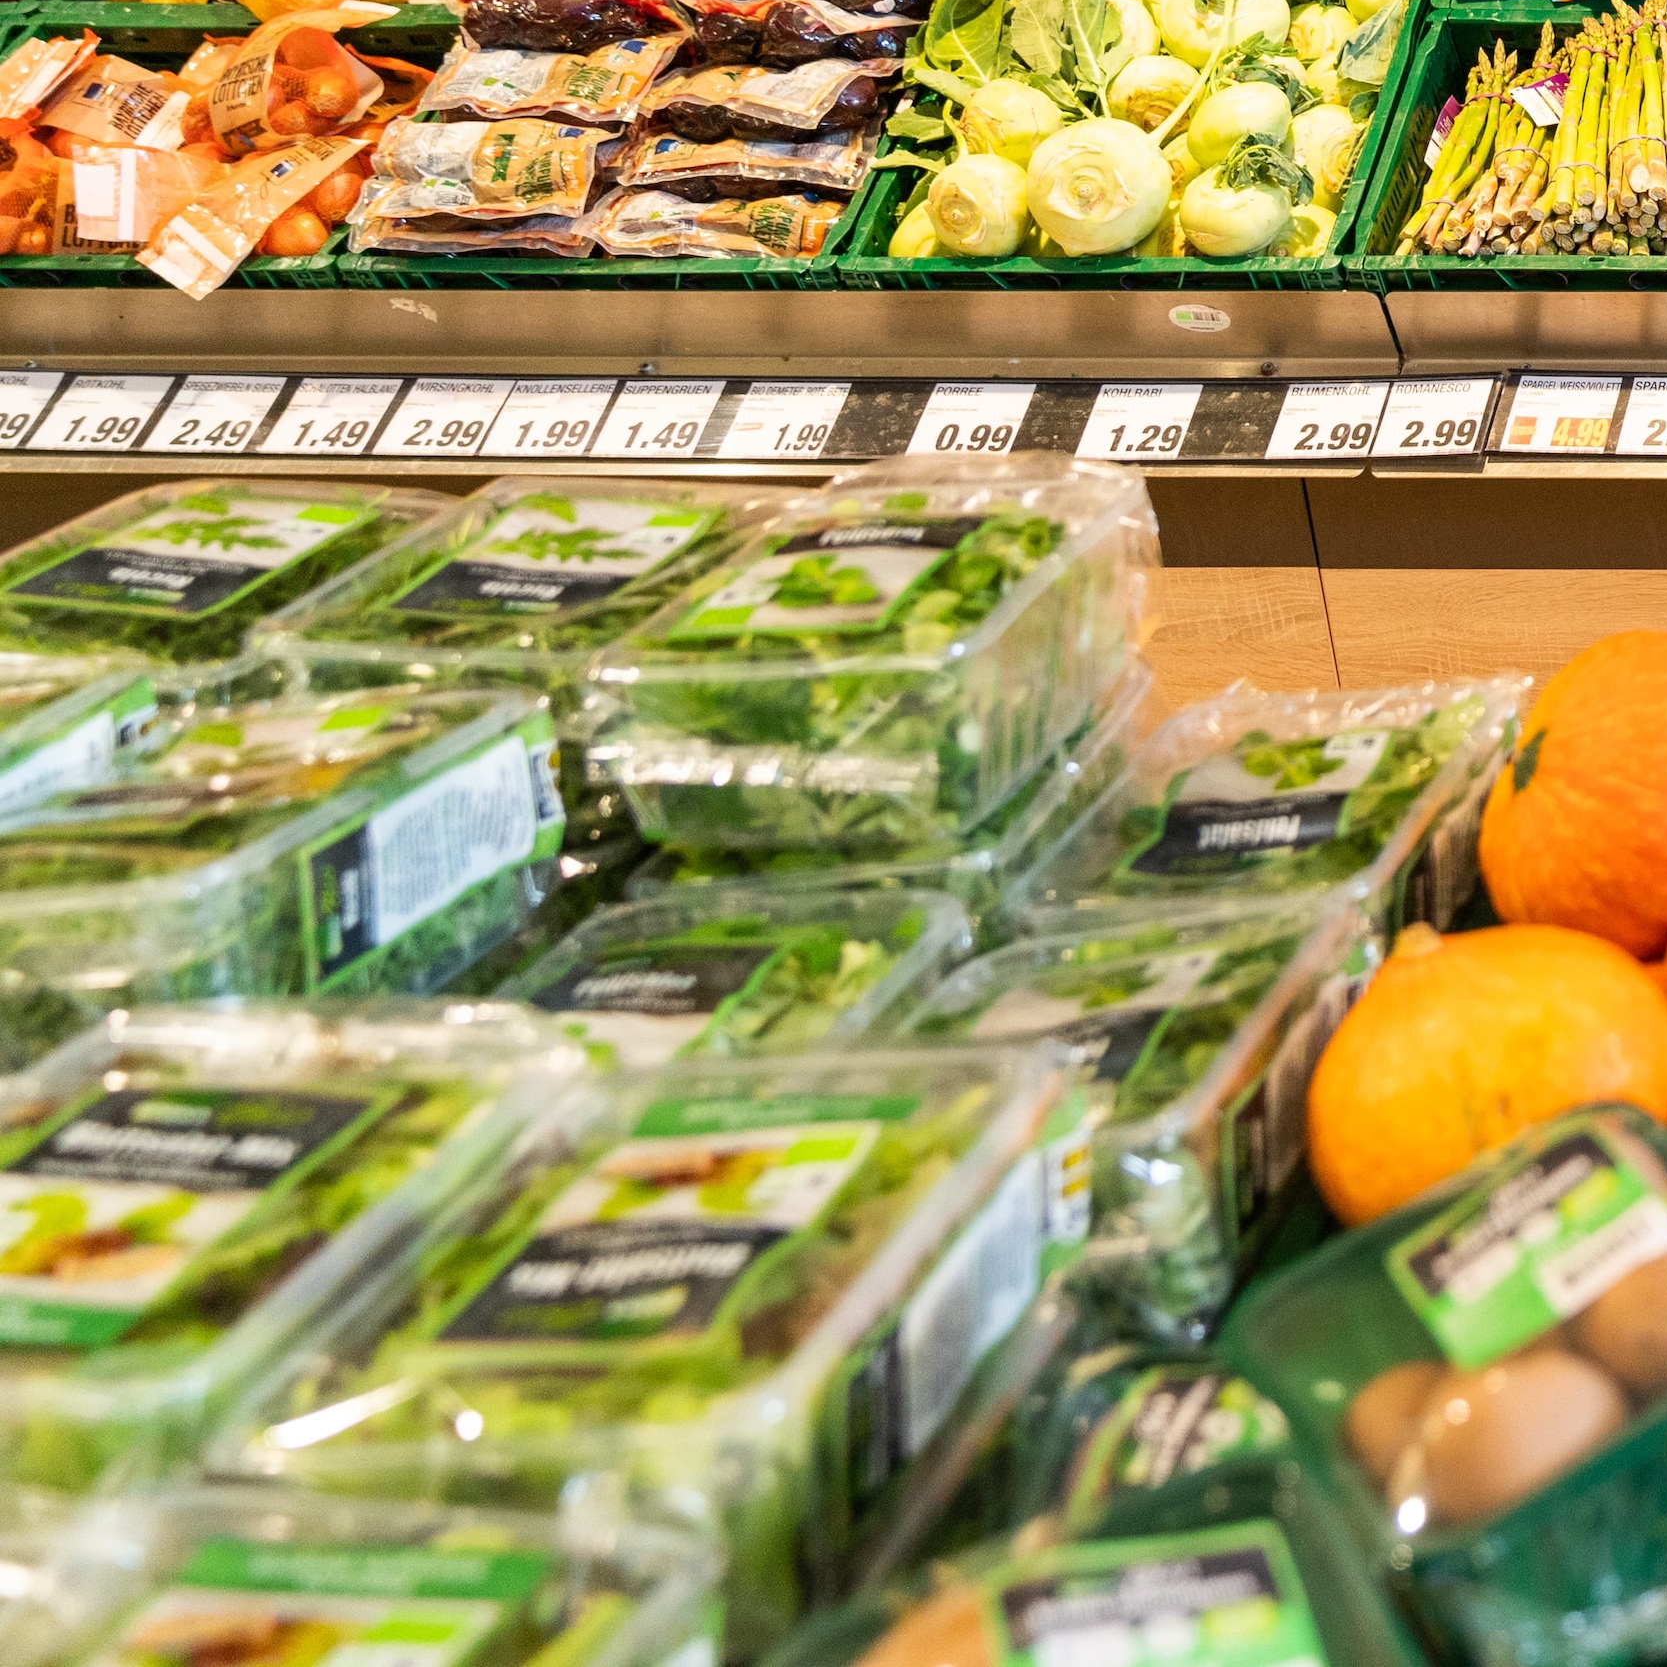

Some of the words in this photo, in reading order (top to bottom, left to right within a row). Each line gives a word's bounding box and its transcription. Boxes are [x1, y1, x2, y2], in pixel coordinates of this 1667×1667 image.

[72, 379, 126, 390] ROTKOHL
[354, 384, 398, 394] HALBLANG
[416, 382, 495, 394] WIRSINGKOHL
[516, 384, 614, 394] KNOLLENSELLERIE
[624, 384, 712, 395] SUPPENGRUEN
[750, 386, 764, 396] BIO
[936, 386, 984, 396] PORREE
[1103, 388, 1163, 398] KOHLRABI
[1291, 386, 1372, 396] BLUMENKOHL
[1396, 382, 1471, 394] ROMANESCO
[1521, 379, 1557, 390] SPARGEL
[1559, 380, 1621, 392] WEISS/VIOLETT
[63, 415, 141, 443] 1.99
[170, 419, 252, 446] 2.49
[294, 420, 370, 448] 1.49
[403, 420, 484, 448] 2.99
[515, 420, 590, 448] 1.99
[624, 421, 699, 448] 1.49
[774, 424, 828, 450] 1.99
[935, 424, 1013, 452] 0.99
[1110, 424, 1182, 452] 1.29
[1294, 423, 1372, 450] 2.99
[1400, 419, 1477, 448] 2.99
[1551, 418, 1611, 447] 4.99
